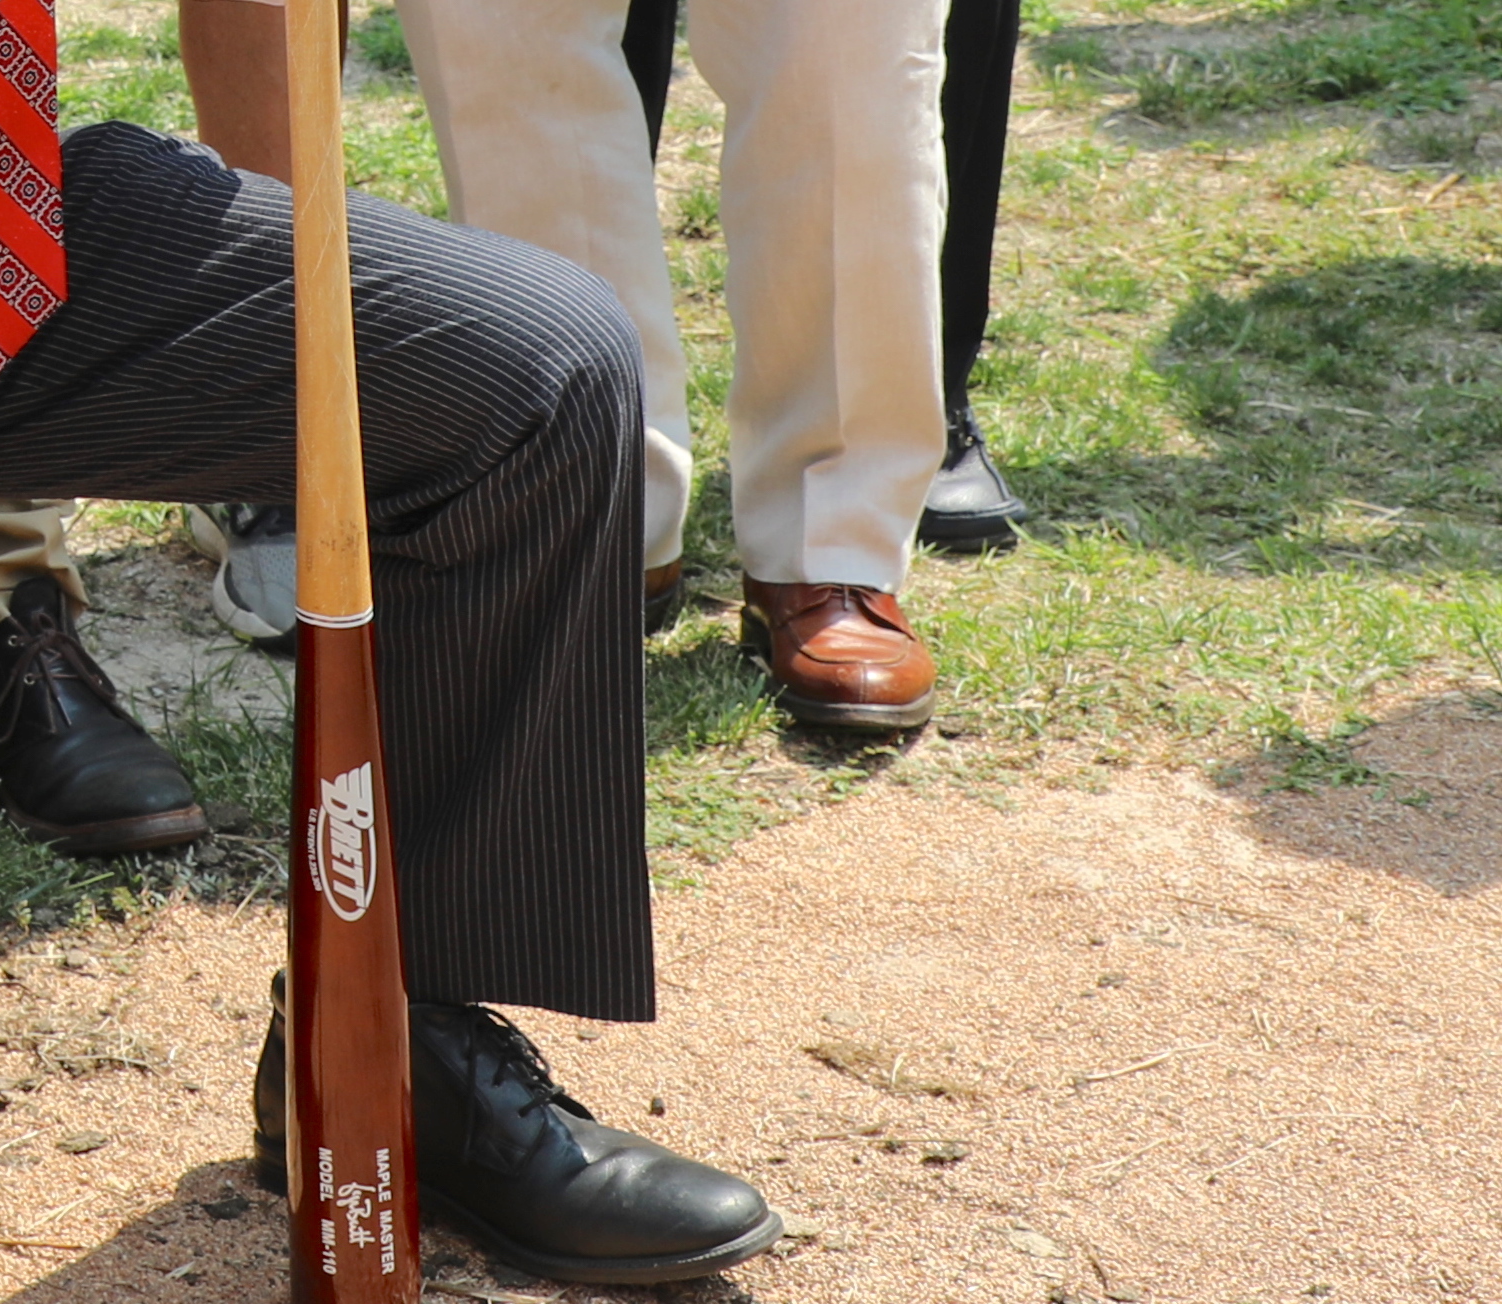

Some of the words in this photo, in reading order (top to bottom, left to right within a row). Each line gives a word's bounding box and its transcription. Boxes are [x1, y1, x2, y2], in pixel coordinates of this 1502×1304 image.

[320, 761, 375, 910] BRETT
[318, 1147, 334, 1202] MODEL
[376, 1148, 392, 1203] MAPLE
[321, 1218, 337, 1276] MM-110
[379, 1209, 396, 1275] MASTER
